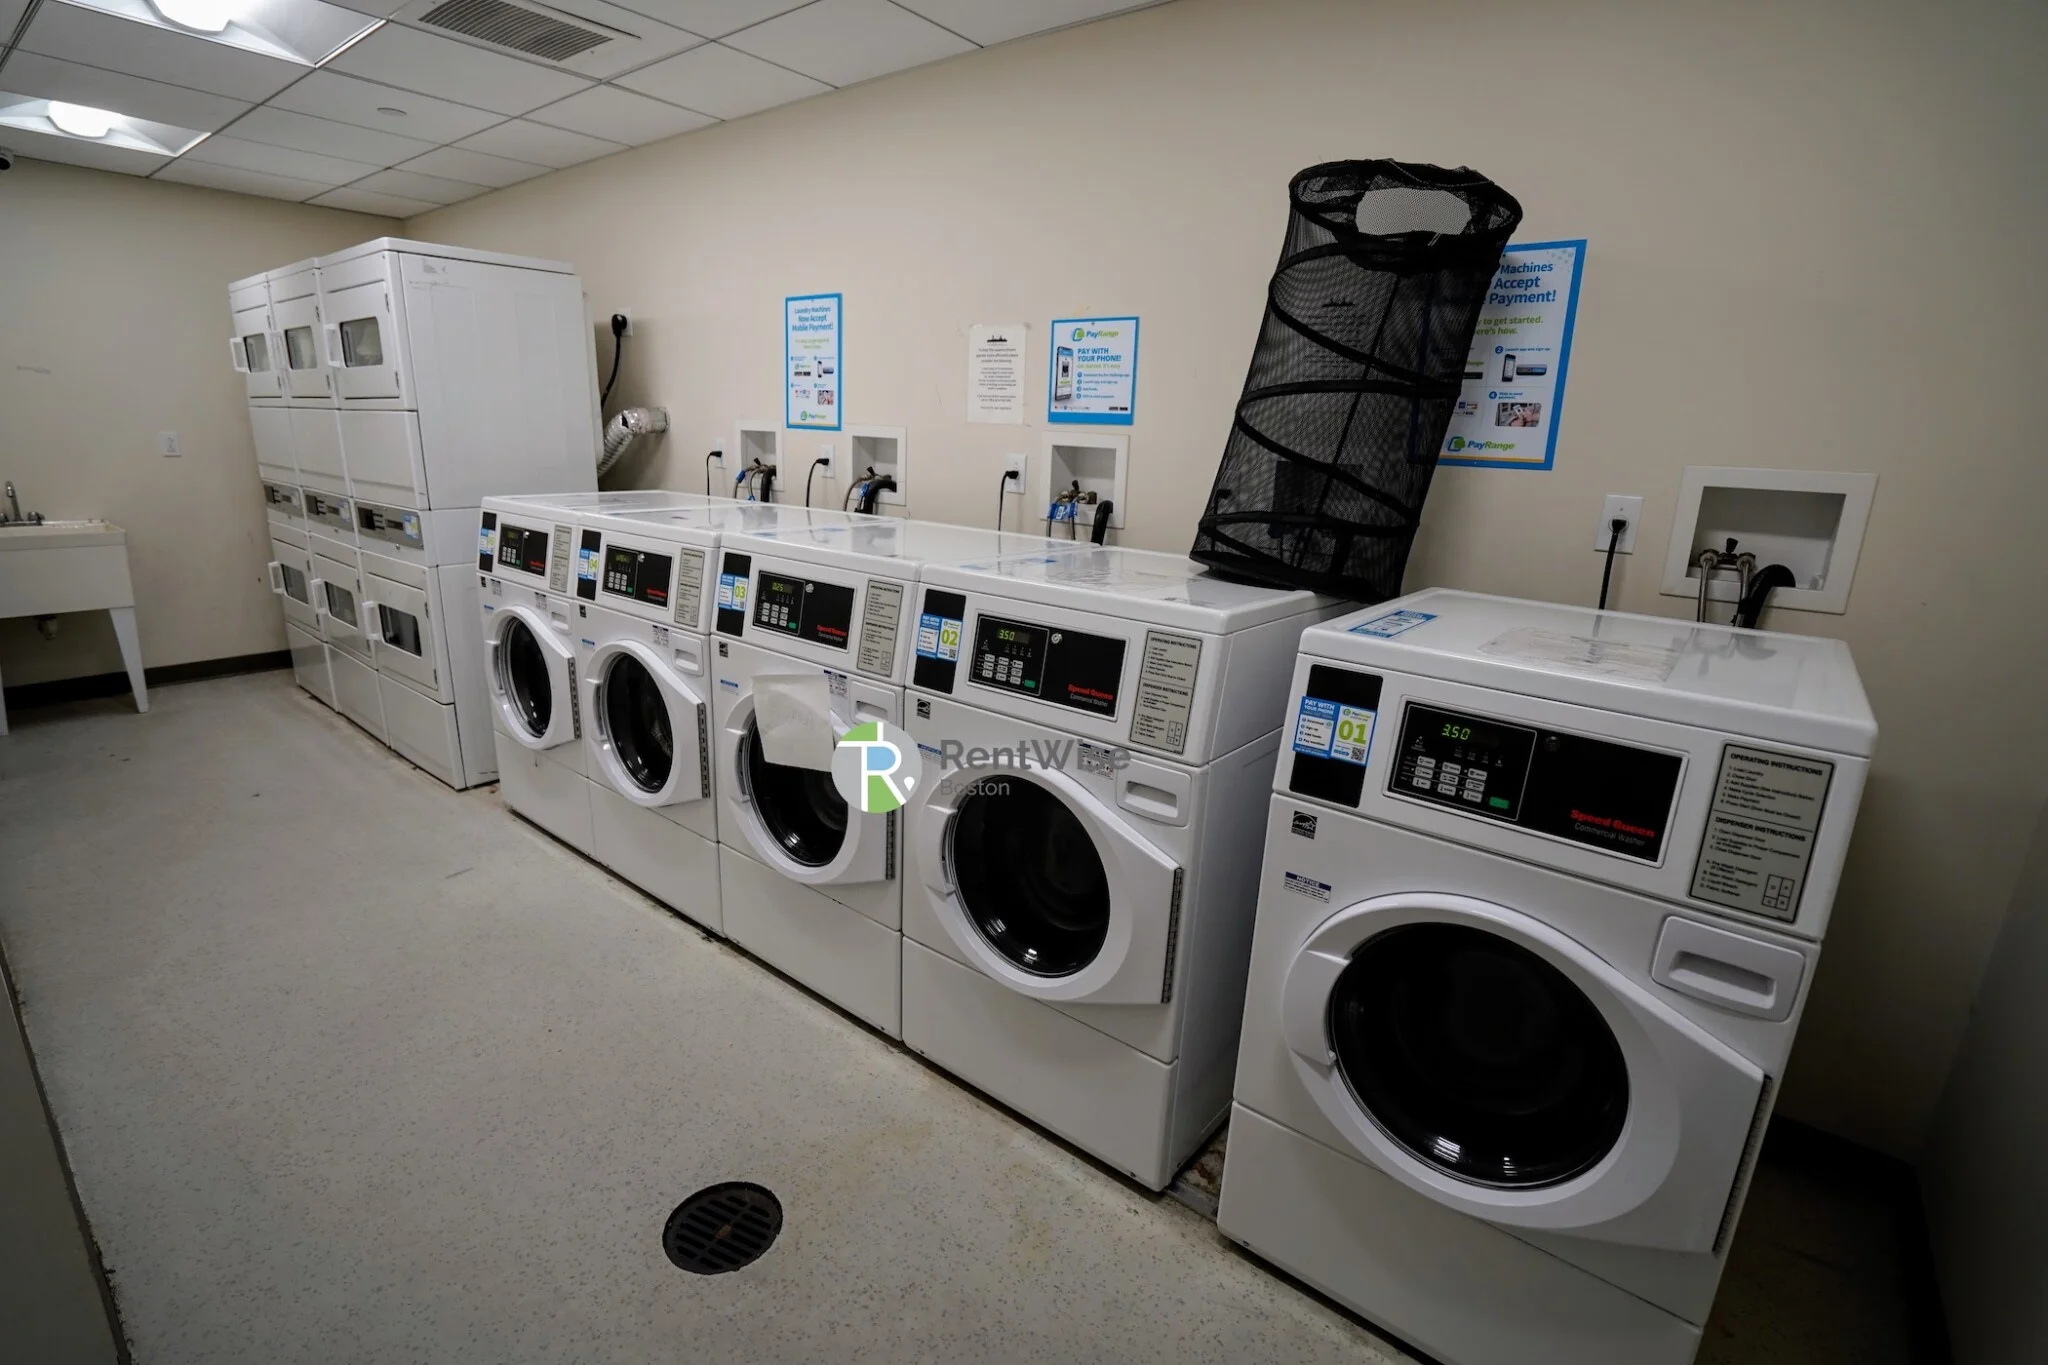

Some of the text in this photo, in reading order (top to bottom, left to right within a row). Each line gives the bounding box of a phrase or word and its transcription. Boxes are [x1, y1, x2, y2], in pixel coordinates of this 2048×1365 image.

[1500, 262, 1553, 274] Machines
[1494, 276, 1540, 290] Accept
[1489, 290, 1556, 307] Payment!
[1483, 317, 1492, 325] to
[1493, 318, 1508, 328] get
[1509, 316, 1544, 325] started.
[1086, 330, 1119, 339] PayRange
[1475, 326, 1518, 336] ere's how.
[1467, 440, 1515, 451] PayRange
[735, 585, 746, 599] 03
[941, 629, 959, 646] 02
[1338, 720, 1366, 745] 01
[1730, 753, 1823, 776] OPERATING INSTRUCTIONS
[1570, 809, 1656, 838] Speed Queen
[1715, 816, 1806, 842] DISPENSER INSTRUCTIONS
[1574, 822, 1646, 846] Commercial Washer
